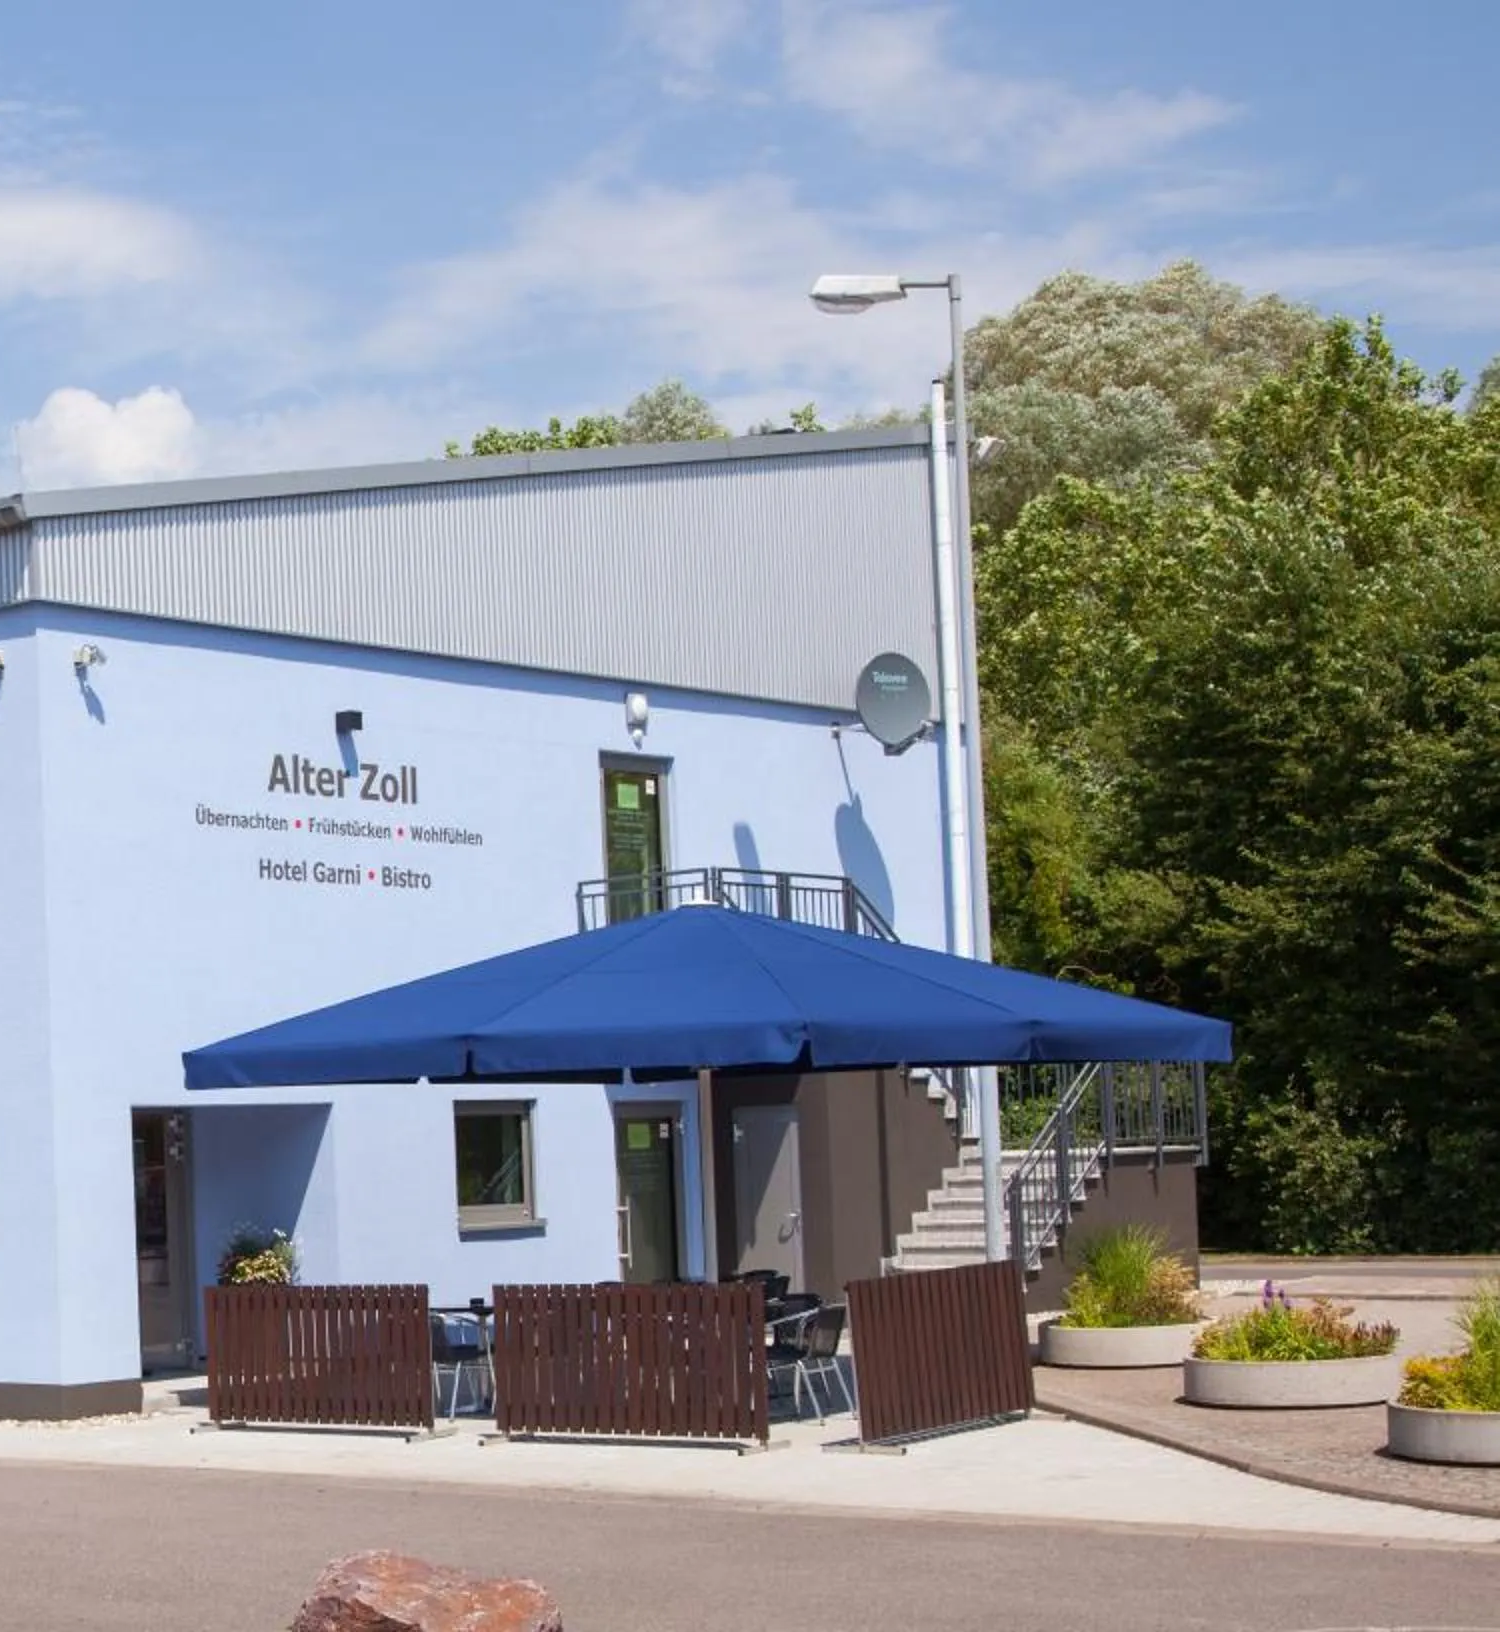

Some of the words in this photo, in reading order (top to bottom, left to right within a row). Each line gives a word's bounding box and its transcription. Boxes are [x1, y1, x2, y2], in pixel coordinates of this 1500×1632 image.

[268, 754, 351, 798] Alter
[359, 763, 418, 804] Zoll
[195, 804, 289, 831] Übernachten
[308, 817, 392, 840] Frühstücken
[410, 826, 483, 846] Wohlfühlen
[259, 858, 308, 882] Hotel
[313, 862, 361, 885] Garni
[382, 866, 432, 890] Bistro
